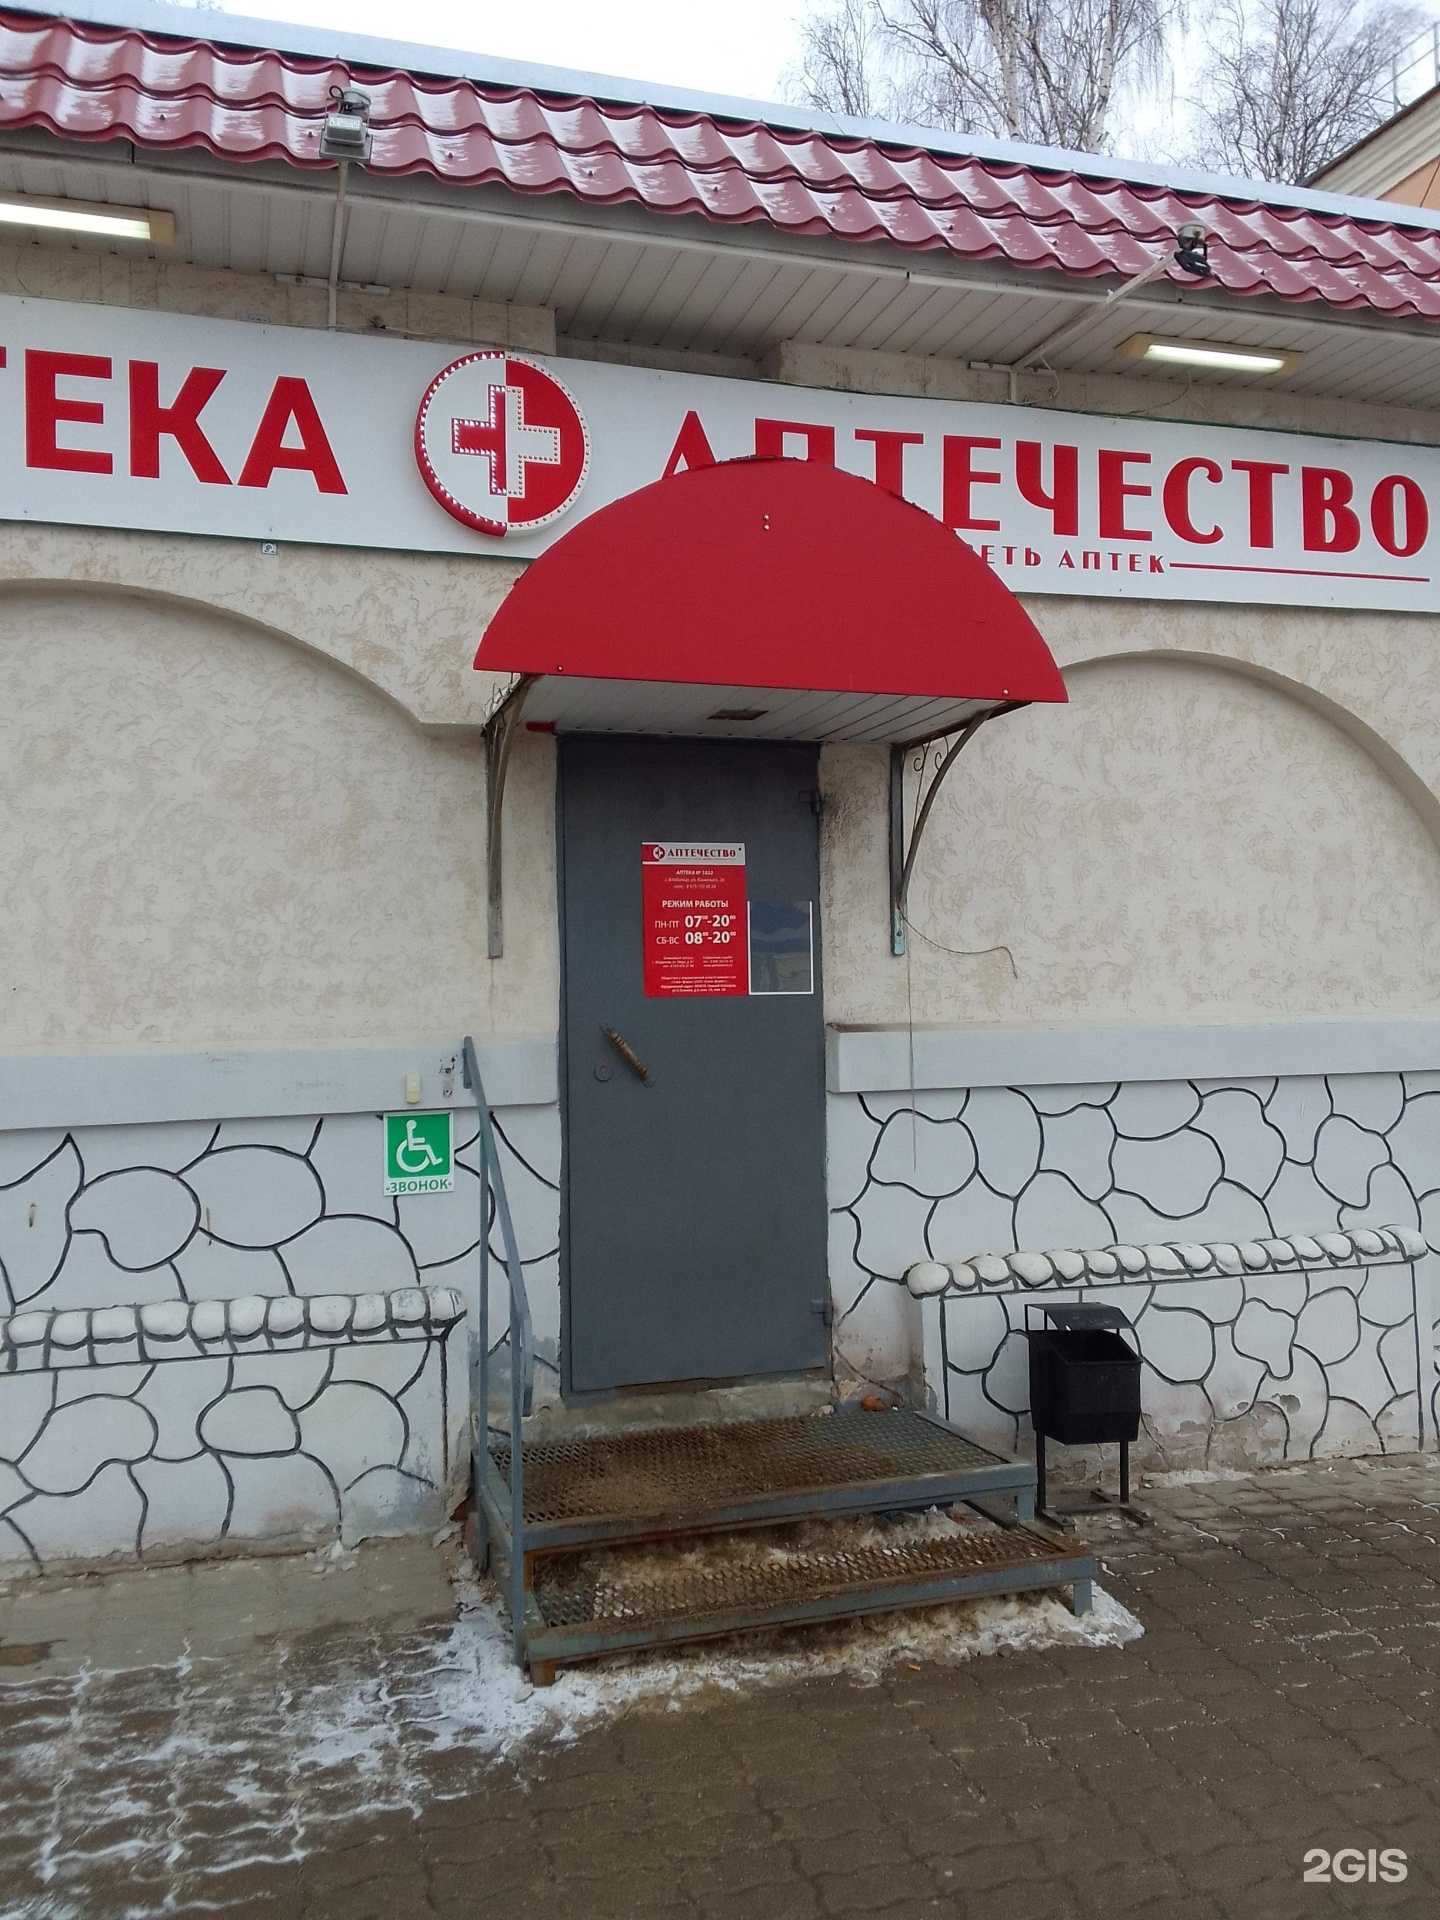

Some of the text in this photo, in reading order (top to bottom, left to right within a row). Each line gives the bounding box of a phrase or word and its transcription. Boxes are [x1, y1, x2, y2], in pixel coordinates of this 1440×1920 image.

[0, 346, 349, 495] ЕКА
[1058, 549, 1165, 574] АПТЕК
[667, 848, 736, 858] АПТЕЧЕСТВО
[662, 899, 729, 908] РЕЖИМ РАБОТЫ
[655, 920, 679, 929] ПН-ПТ
[656, 936, 680, 945] СБ-ВС
